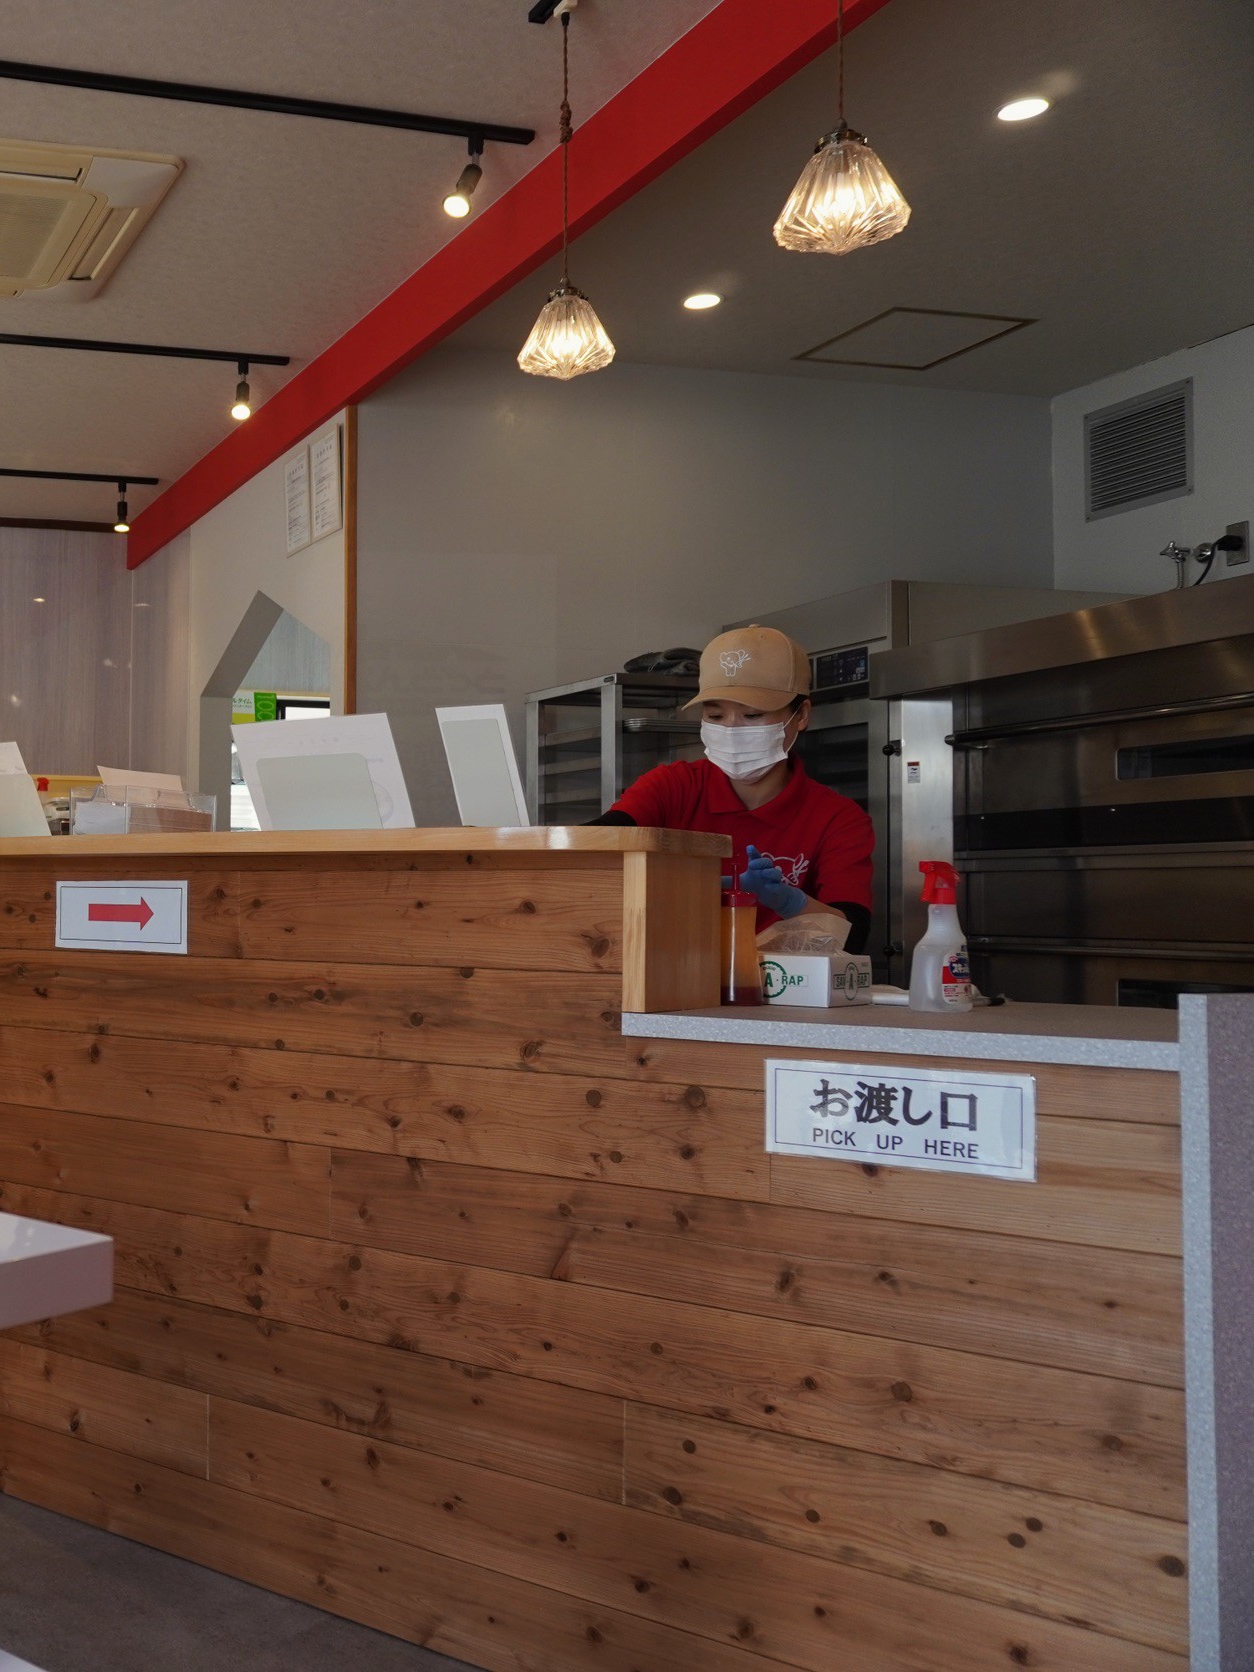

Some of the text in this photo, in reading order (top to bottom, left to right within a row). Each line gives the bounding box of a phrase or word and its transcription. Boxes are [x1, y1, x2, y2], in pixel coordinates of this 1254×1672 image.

[781, 975, 804, 985] RAP
[809, 1078, 979, 1132] お渡し口
[812, 1127, 979, 1159] PICK UP HERE
